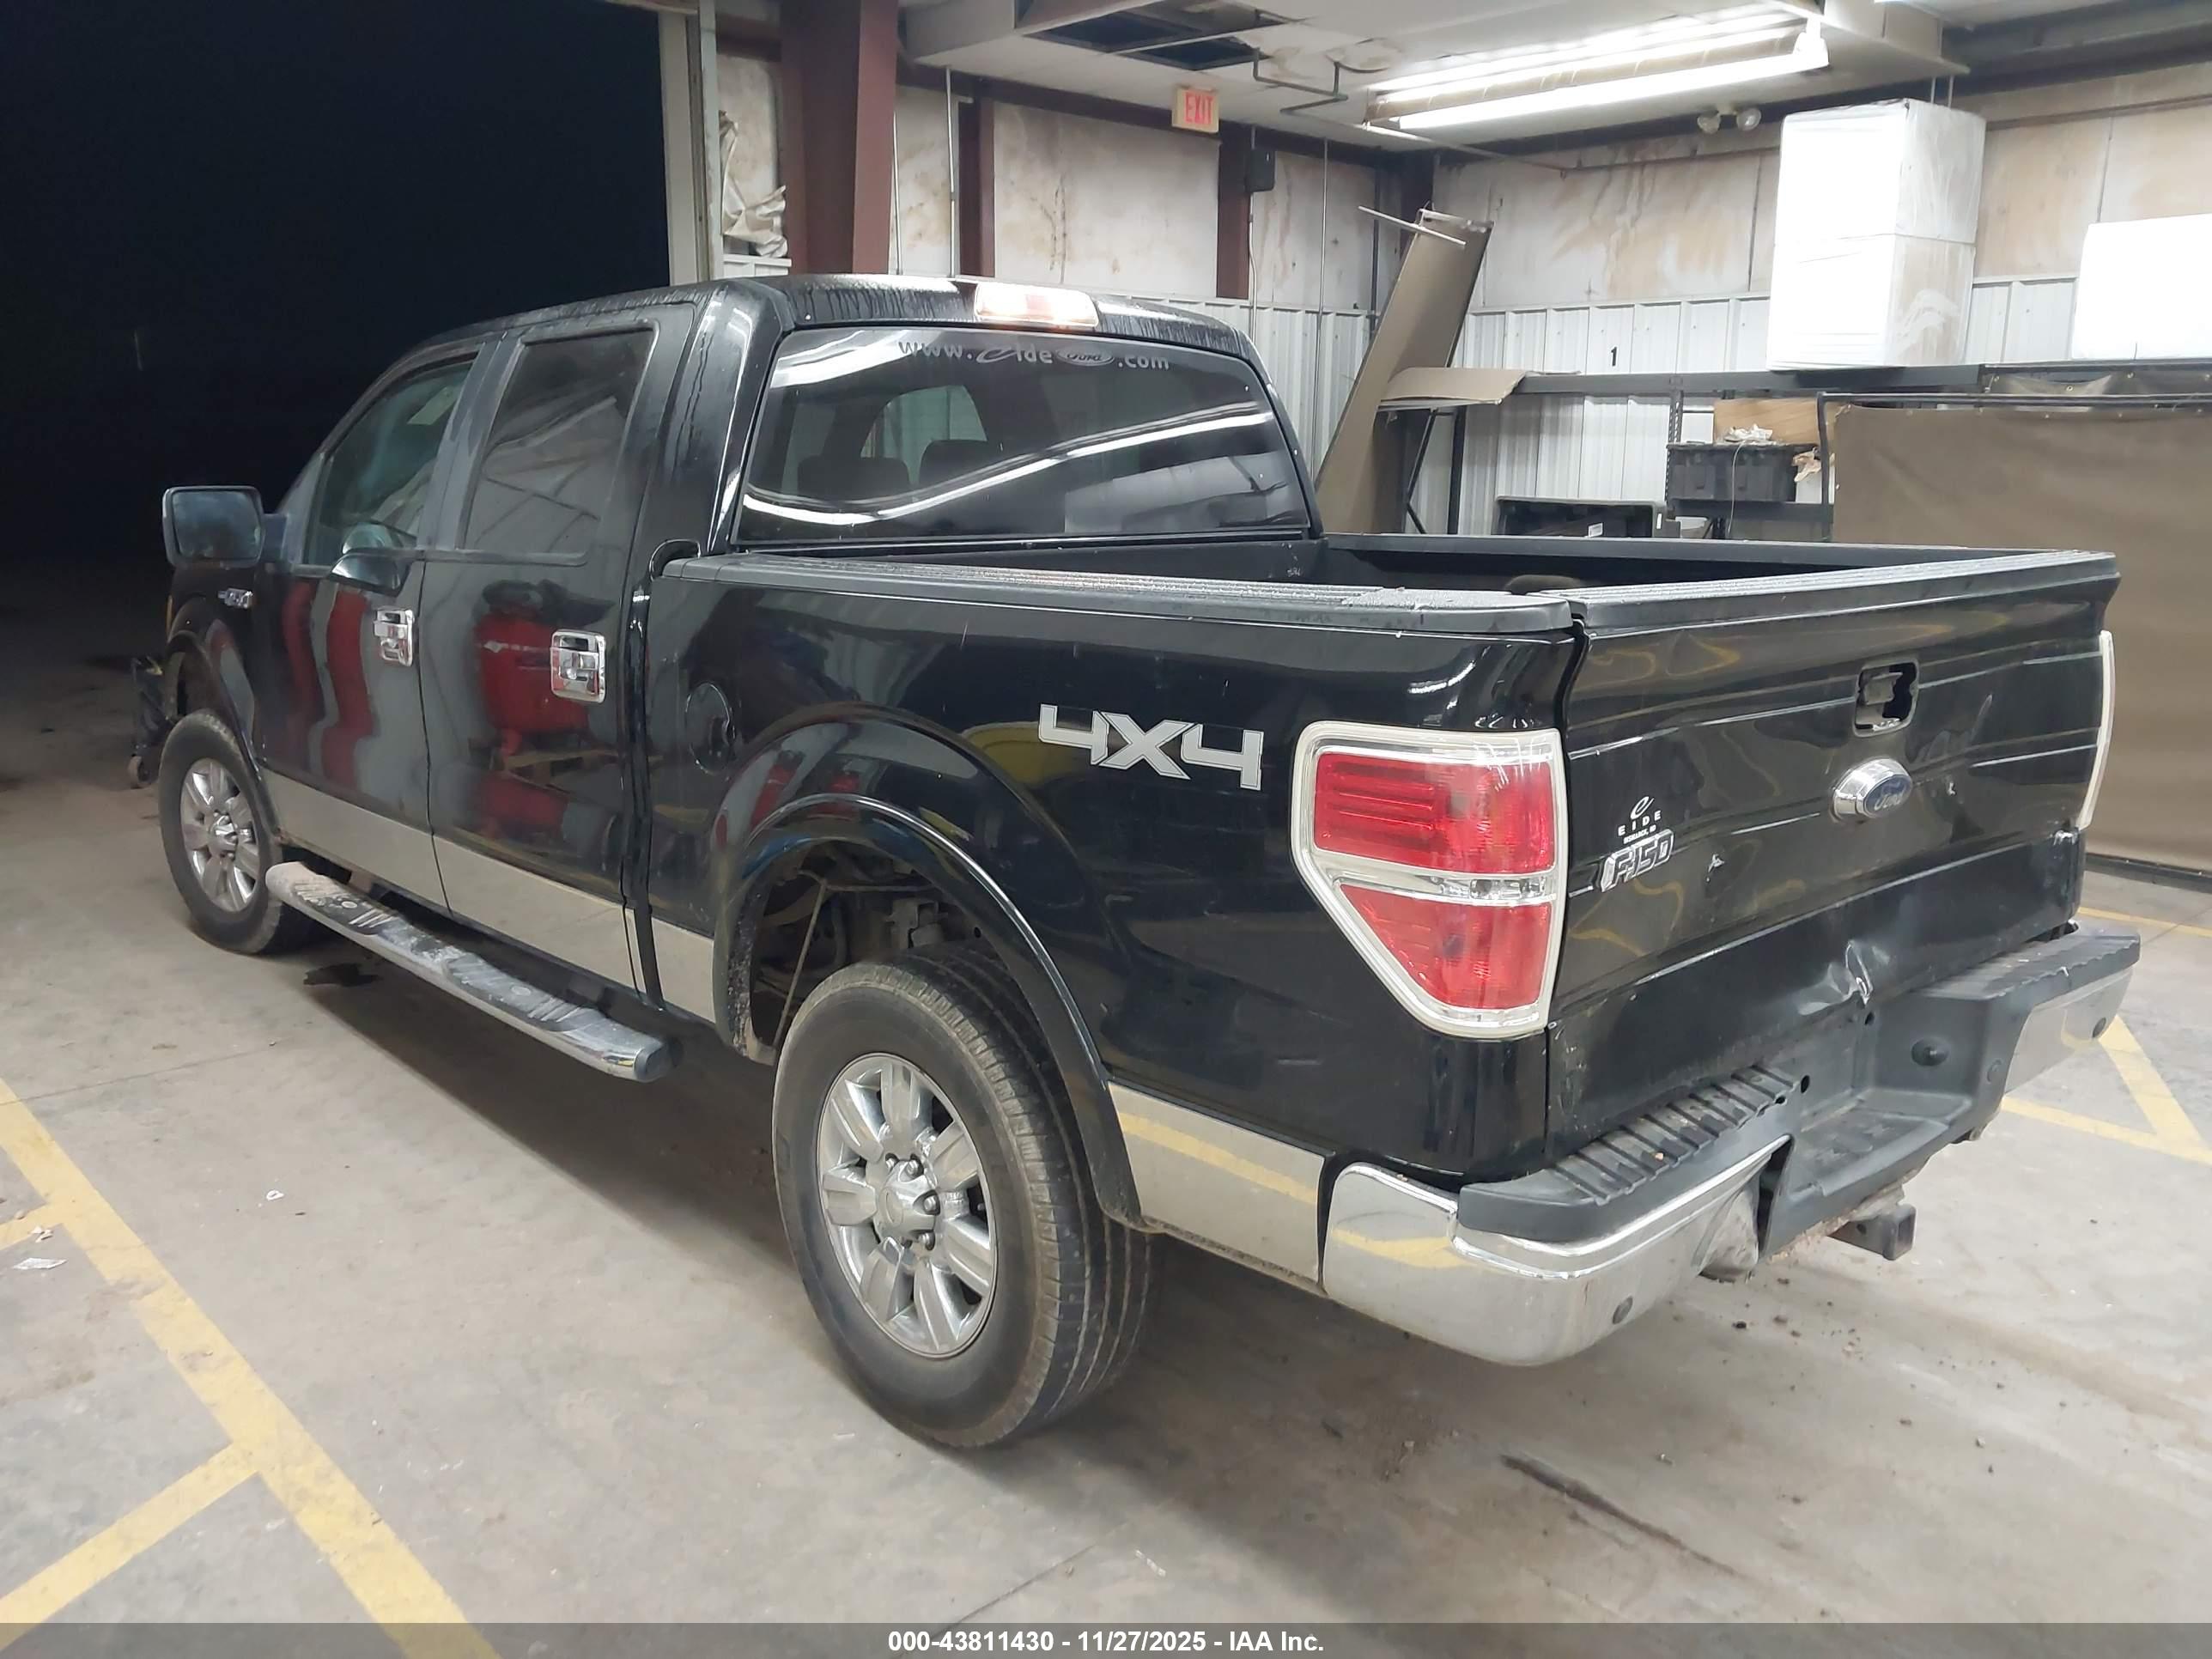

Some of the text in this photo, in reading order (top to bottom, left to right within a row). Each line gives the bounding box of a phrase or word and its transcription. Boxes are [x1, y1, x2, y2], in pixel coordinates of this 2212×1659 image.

[1184, 92, 1214, 125] EXIT
[1610, 345, 1618, 368] 1
[1618, 810, 1662, 836] EIDE
